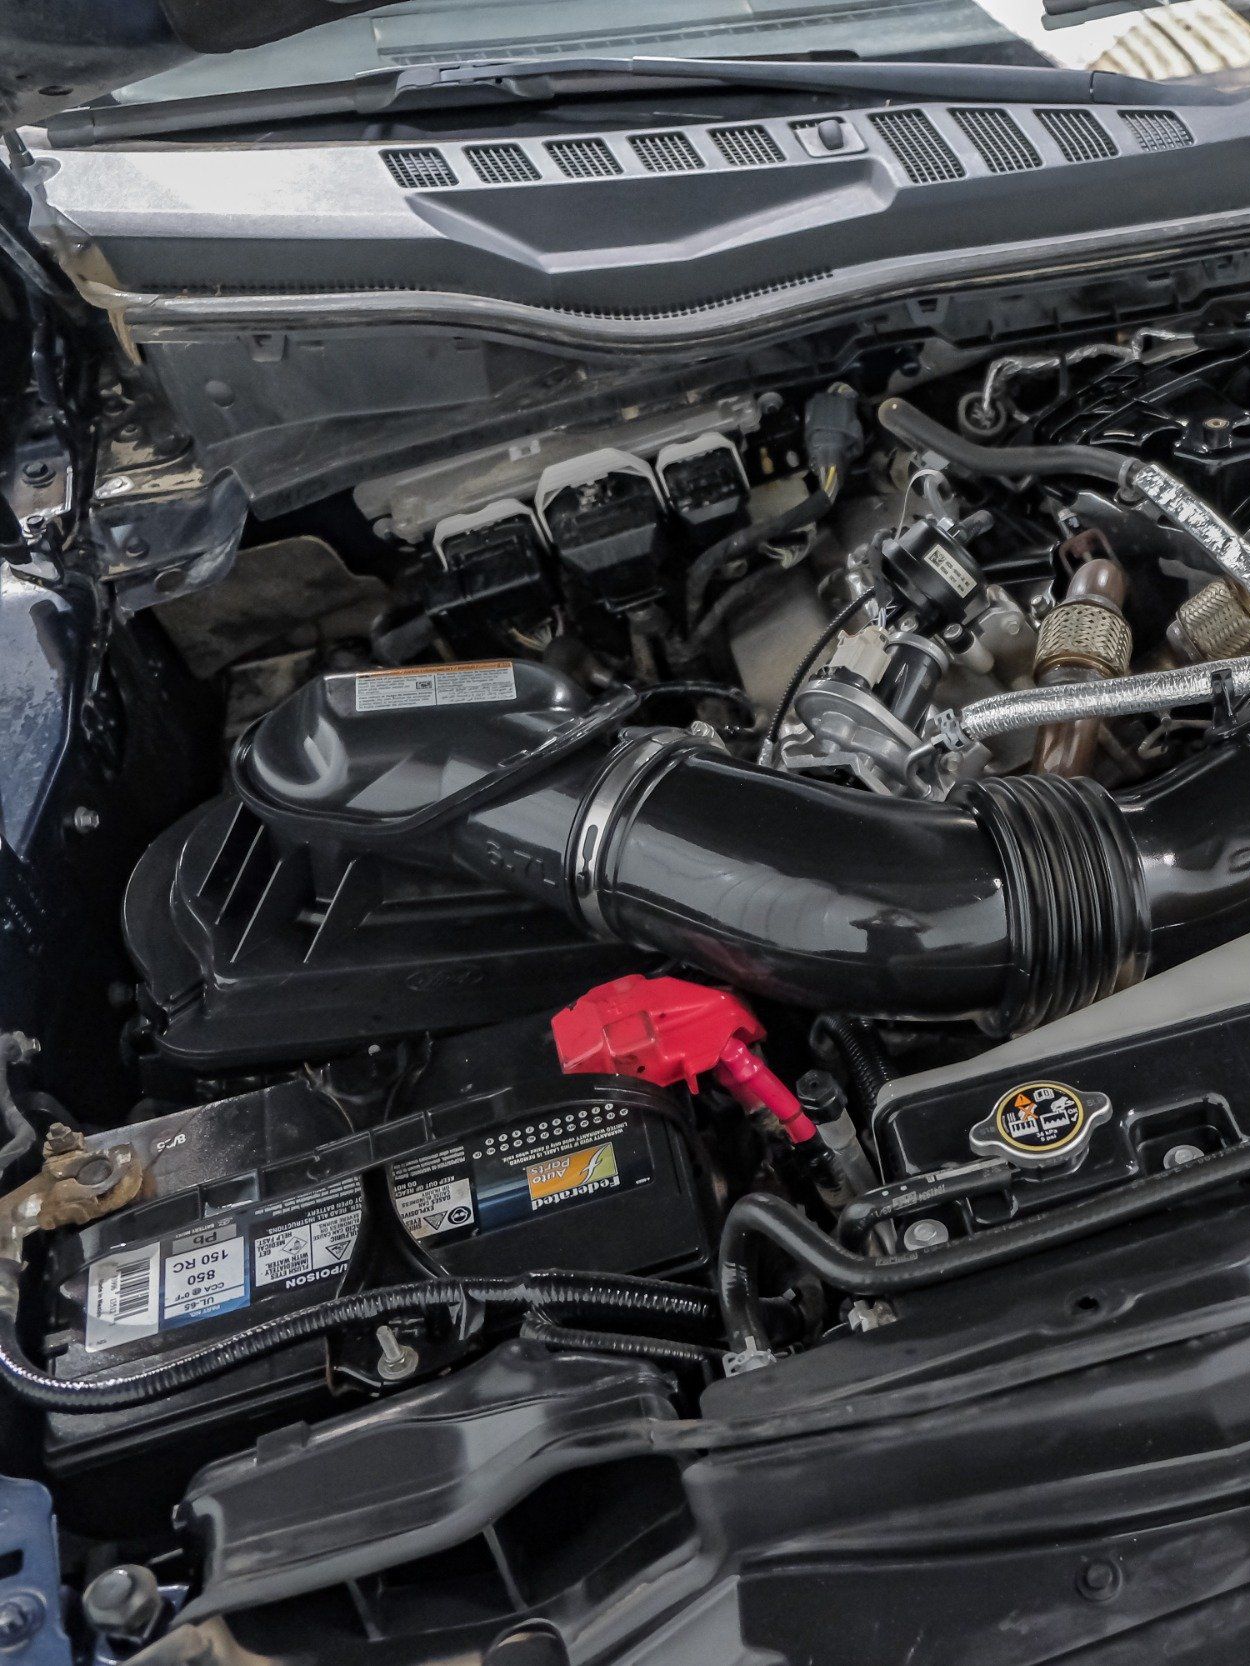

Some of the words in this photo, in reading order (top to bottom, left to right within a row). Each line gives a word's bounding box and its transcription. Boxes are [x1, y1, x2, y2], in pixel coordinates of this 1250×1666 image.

[606, 1122, 628, 1132] LIMITED
[1045, 1128, 1058, 1136] kPa
[577, 1129, 606, 1140] WARRANTY
[594, 1128, 624, 1139] WARRANTY
[1046, 1134, 1057, 1142] psi
[560, 1143, 572, 1151] THIS
[530, 1158, 570, 1174] Parts
[439, 1176, 455, 1185] KEEP
[532, 1168, 566, 1184] Auto
[426, 1181, 437, 1189] OUT
[532, 1175, 620, 1211] Federated
[336, 1200, 354, 1208] OPEN
[316, 1212, 329, 1220] ALL
[330, 1208, 347, 1217] READ
[266, 1217, 316, 1234] INSTRUCTIONS.
[193, 1232, 217, 1244] Pb
[276, 1232, 292, 1241] HELP
[313, 1231, 331, 1241] CAUSE
[257, 1237, 274, 1246] FAST.
[258, 1240, 286, 1252] MEDICAL
[201, 1249, 228, 1265] 150
[260, 1250, 271, 1258] GET
[292, 1253, 308, 1262] WITH
[173, 1259, 196, 1273] RC
[265, 1259, 308, 1276] IMMEDIATELY
[266, 1258, 290, 1268] WATER.
[288, 1264, 308, 1275] FLUSH
[188, 1270, 215, 1285] 850
[271, 1270, 287, 1280] EYES
[204, 1282, 224, 1292] CCA
[184, 1297, 214, 1311] UL-65
[204, 1305, 220, 1314] PART
